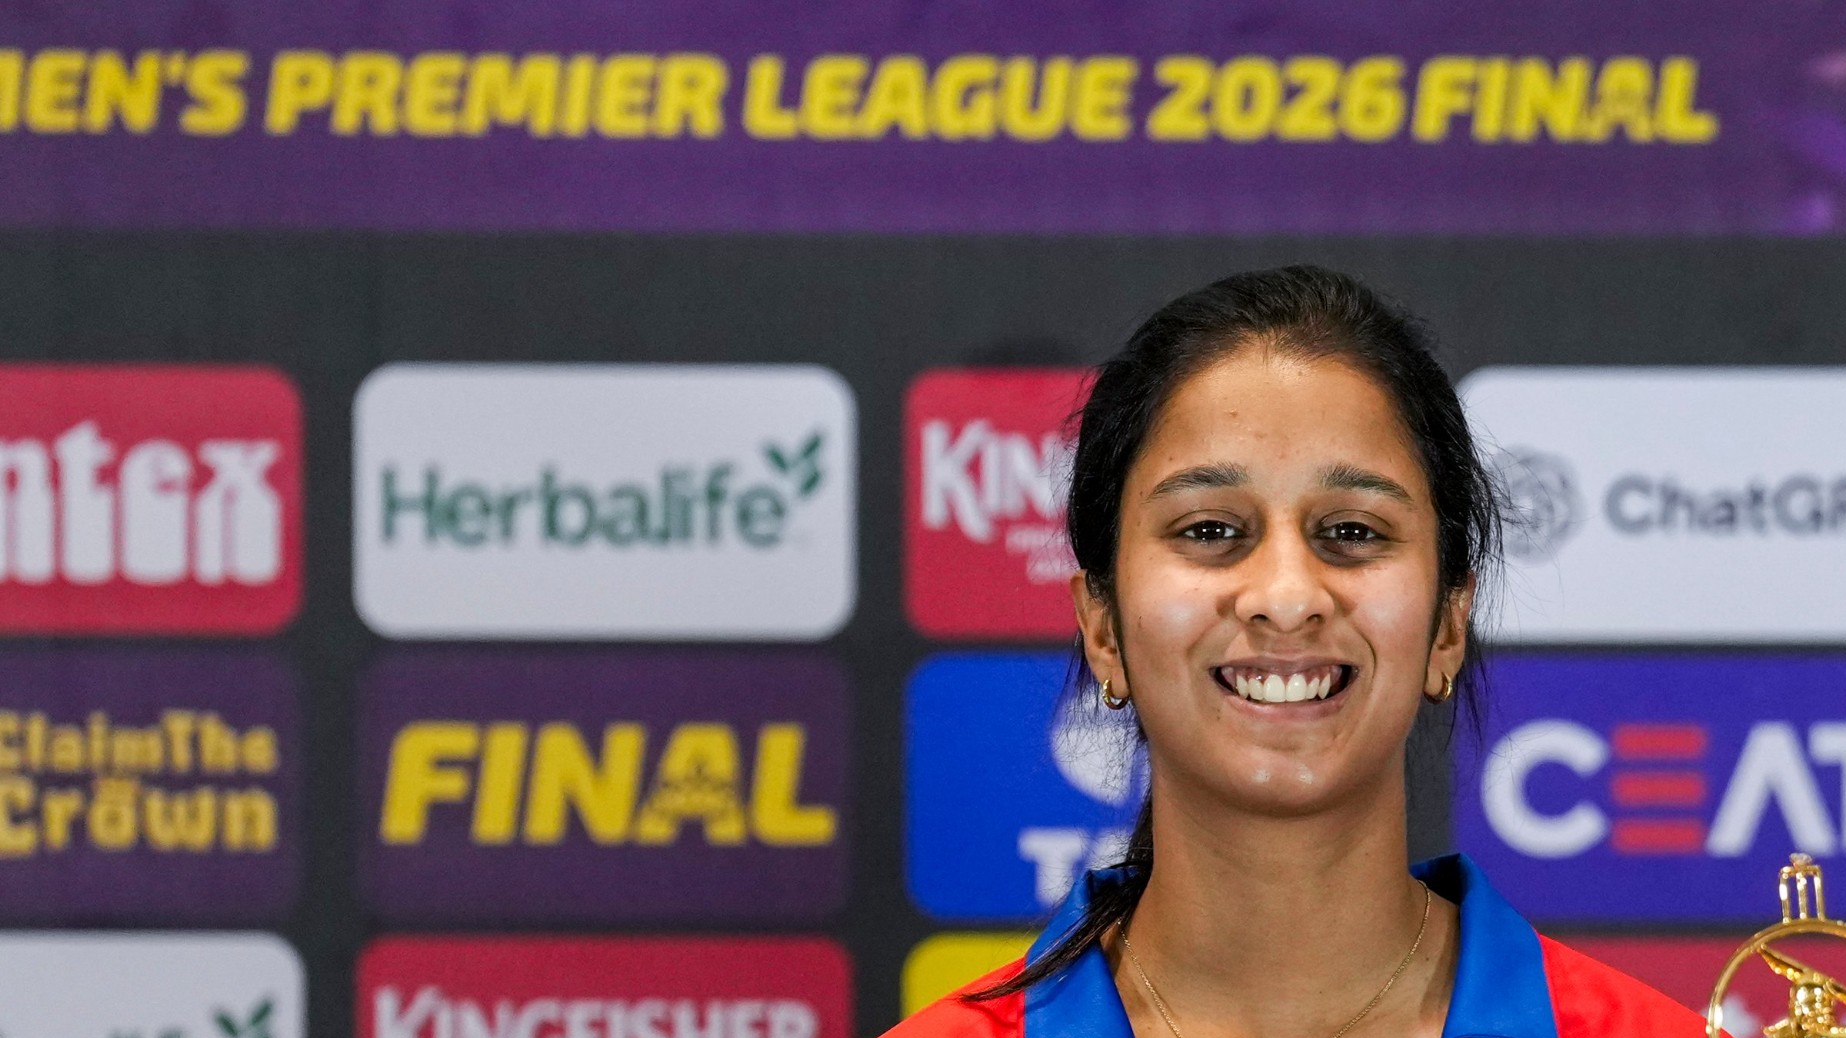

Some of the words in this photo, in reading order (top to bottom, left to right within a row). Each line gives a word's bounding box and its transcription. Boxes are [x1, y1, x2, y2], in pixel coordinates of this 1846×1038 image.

[0, 50, 249, 135] EN'S
[266, 52, 728, 137] PREMIER
[742, 54, 1138, 140] LEAGUE
[1145, 55, 1406, 141] 2026
[1411, 56, 1720, 142] FINAL
[379, 459, 787, 549] Herbalife
[381, 721, 837, 845] FINAL
